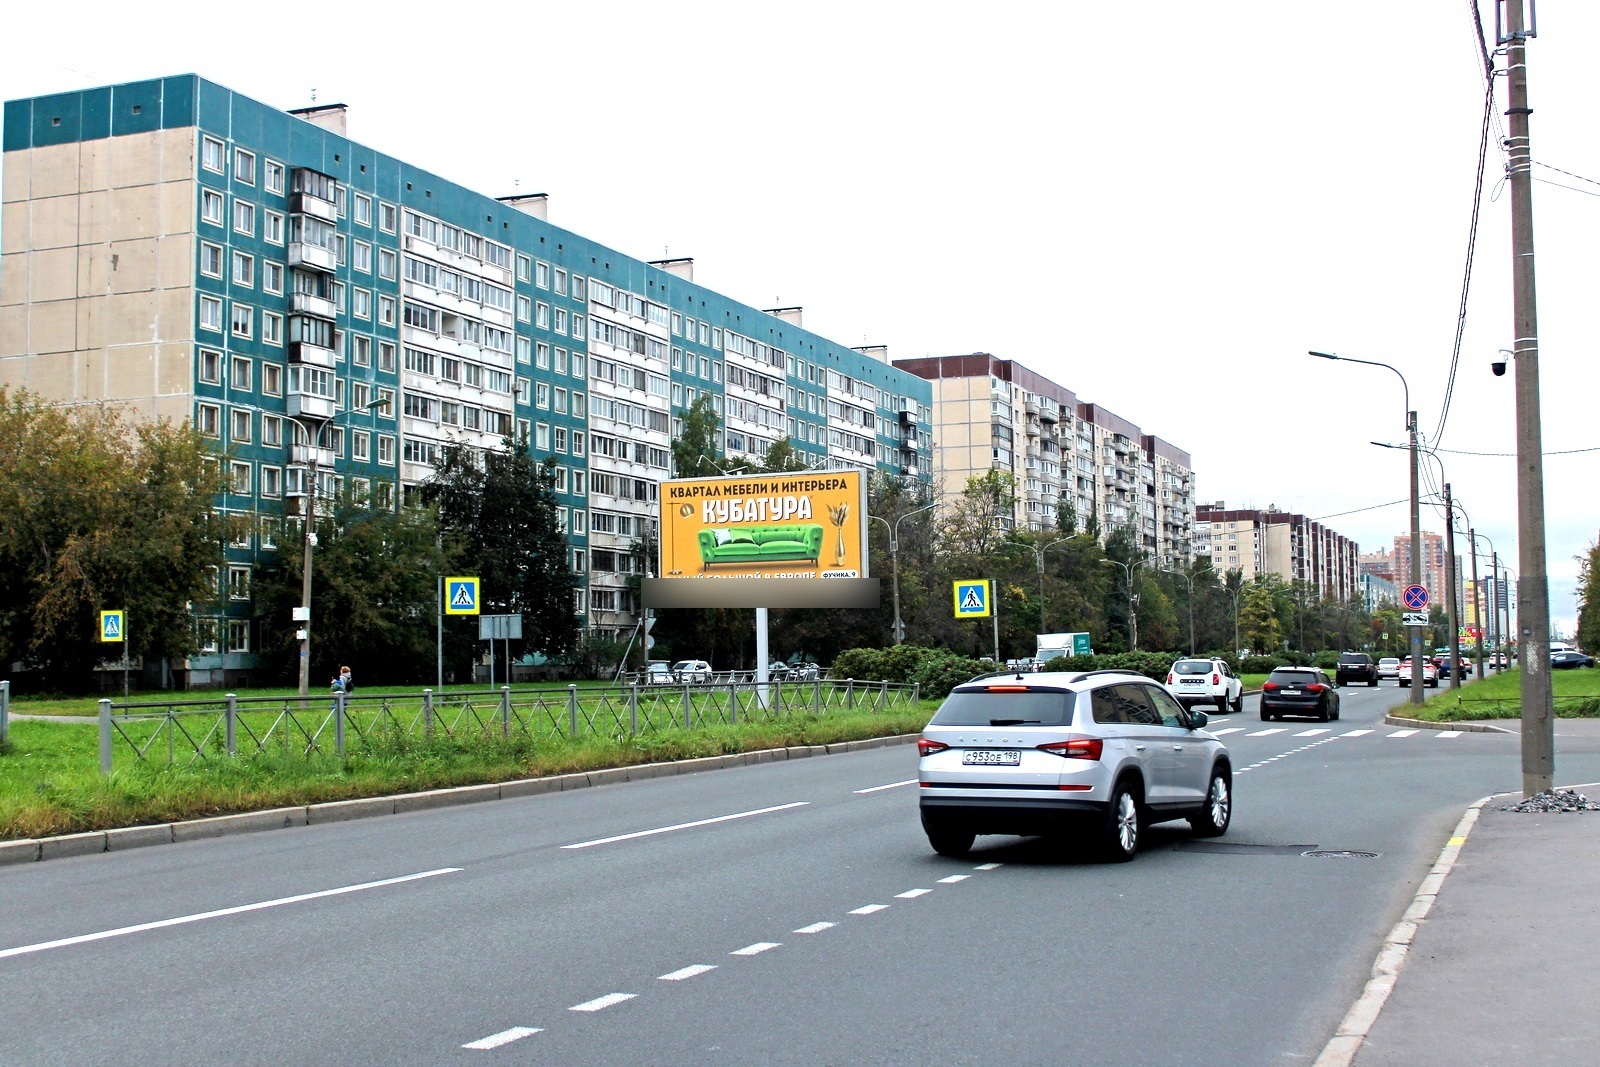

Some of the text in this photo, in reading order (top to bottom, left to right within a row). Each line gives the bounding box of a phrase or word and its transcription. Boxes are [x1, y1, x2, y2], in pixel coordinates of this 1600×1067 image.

[670, 478, 847, 498] КВАРТАЛ МЕБЕЛИ И ИНТЕРЬЕРА
[703, 496, 812, 523] КУБАТУРА
[1003, 751, 1018, 760] 198
